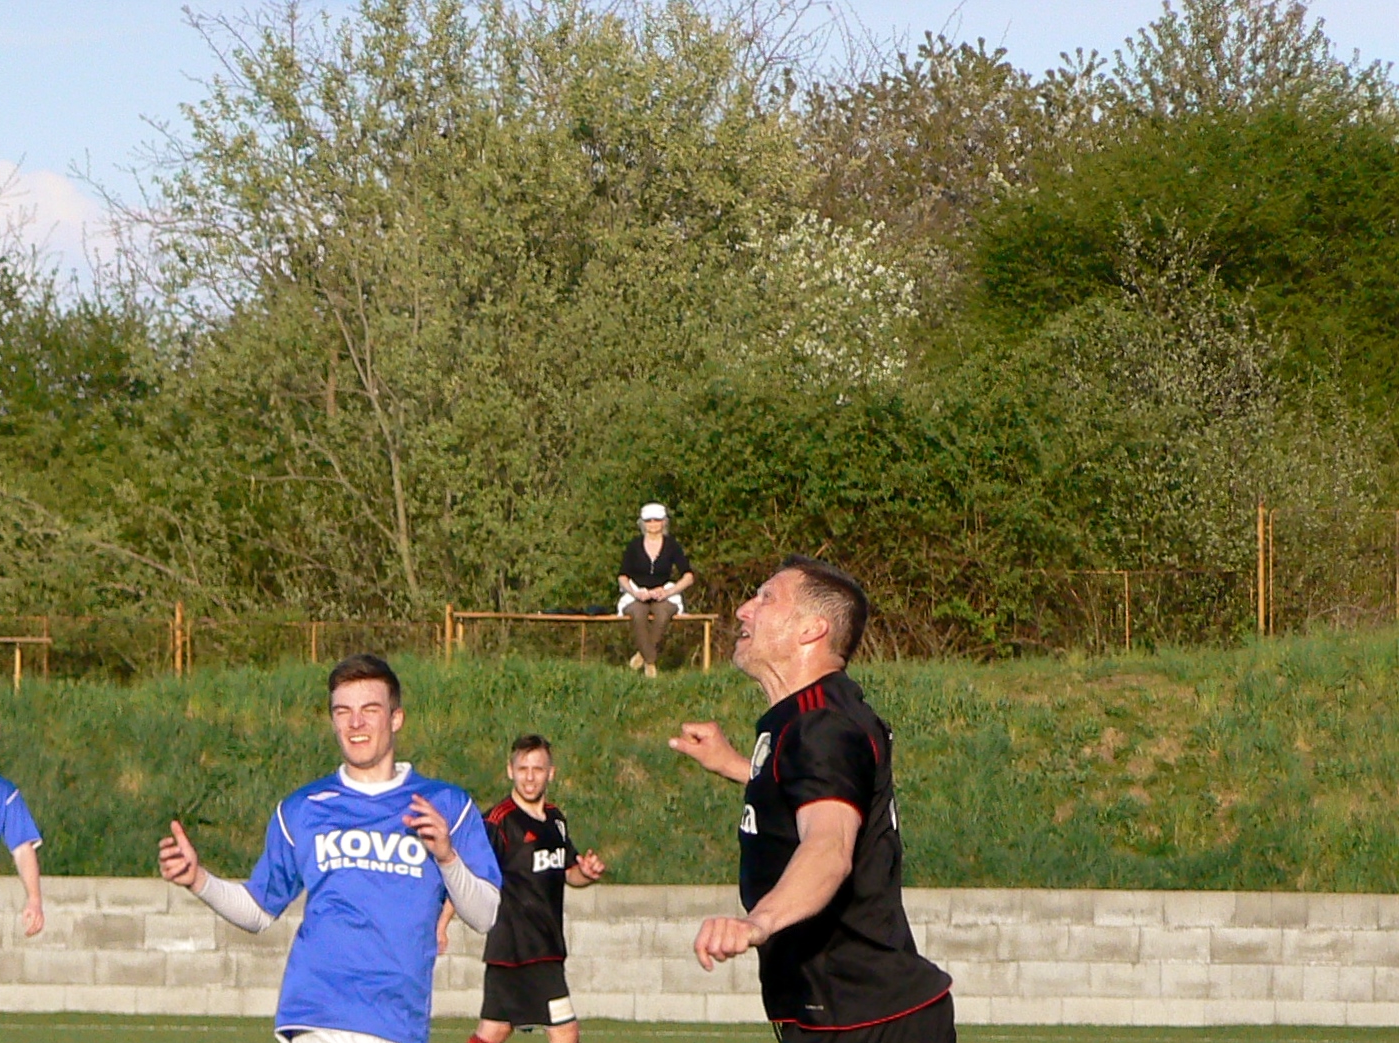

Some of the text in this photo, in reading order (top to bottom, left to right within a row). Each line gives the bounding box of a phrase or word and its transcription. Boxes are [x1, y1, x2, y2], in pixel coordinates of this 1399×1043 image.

[315, 829, 427, 865] KOVO
[532, 847, 566, 873] Bell
[317, 857, 423, 878] VELENICE
